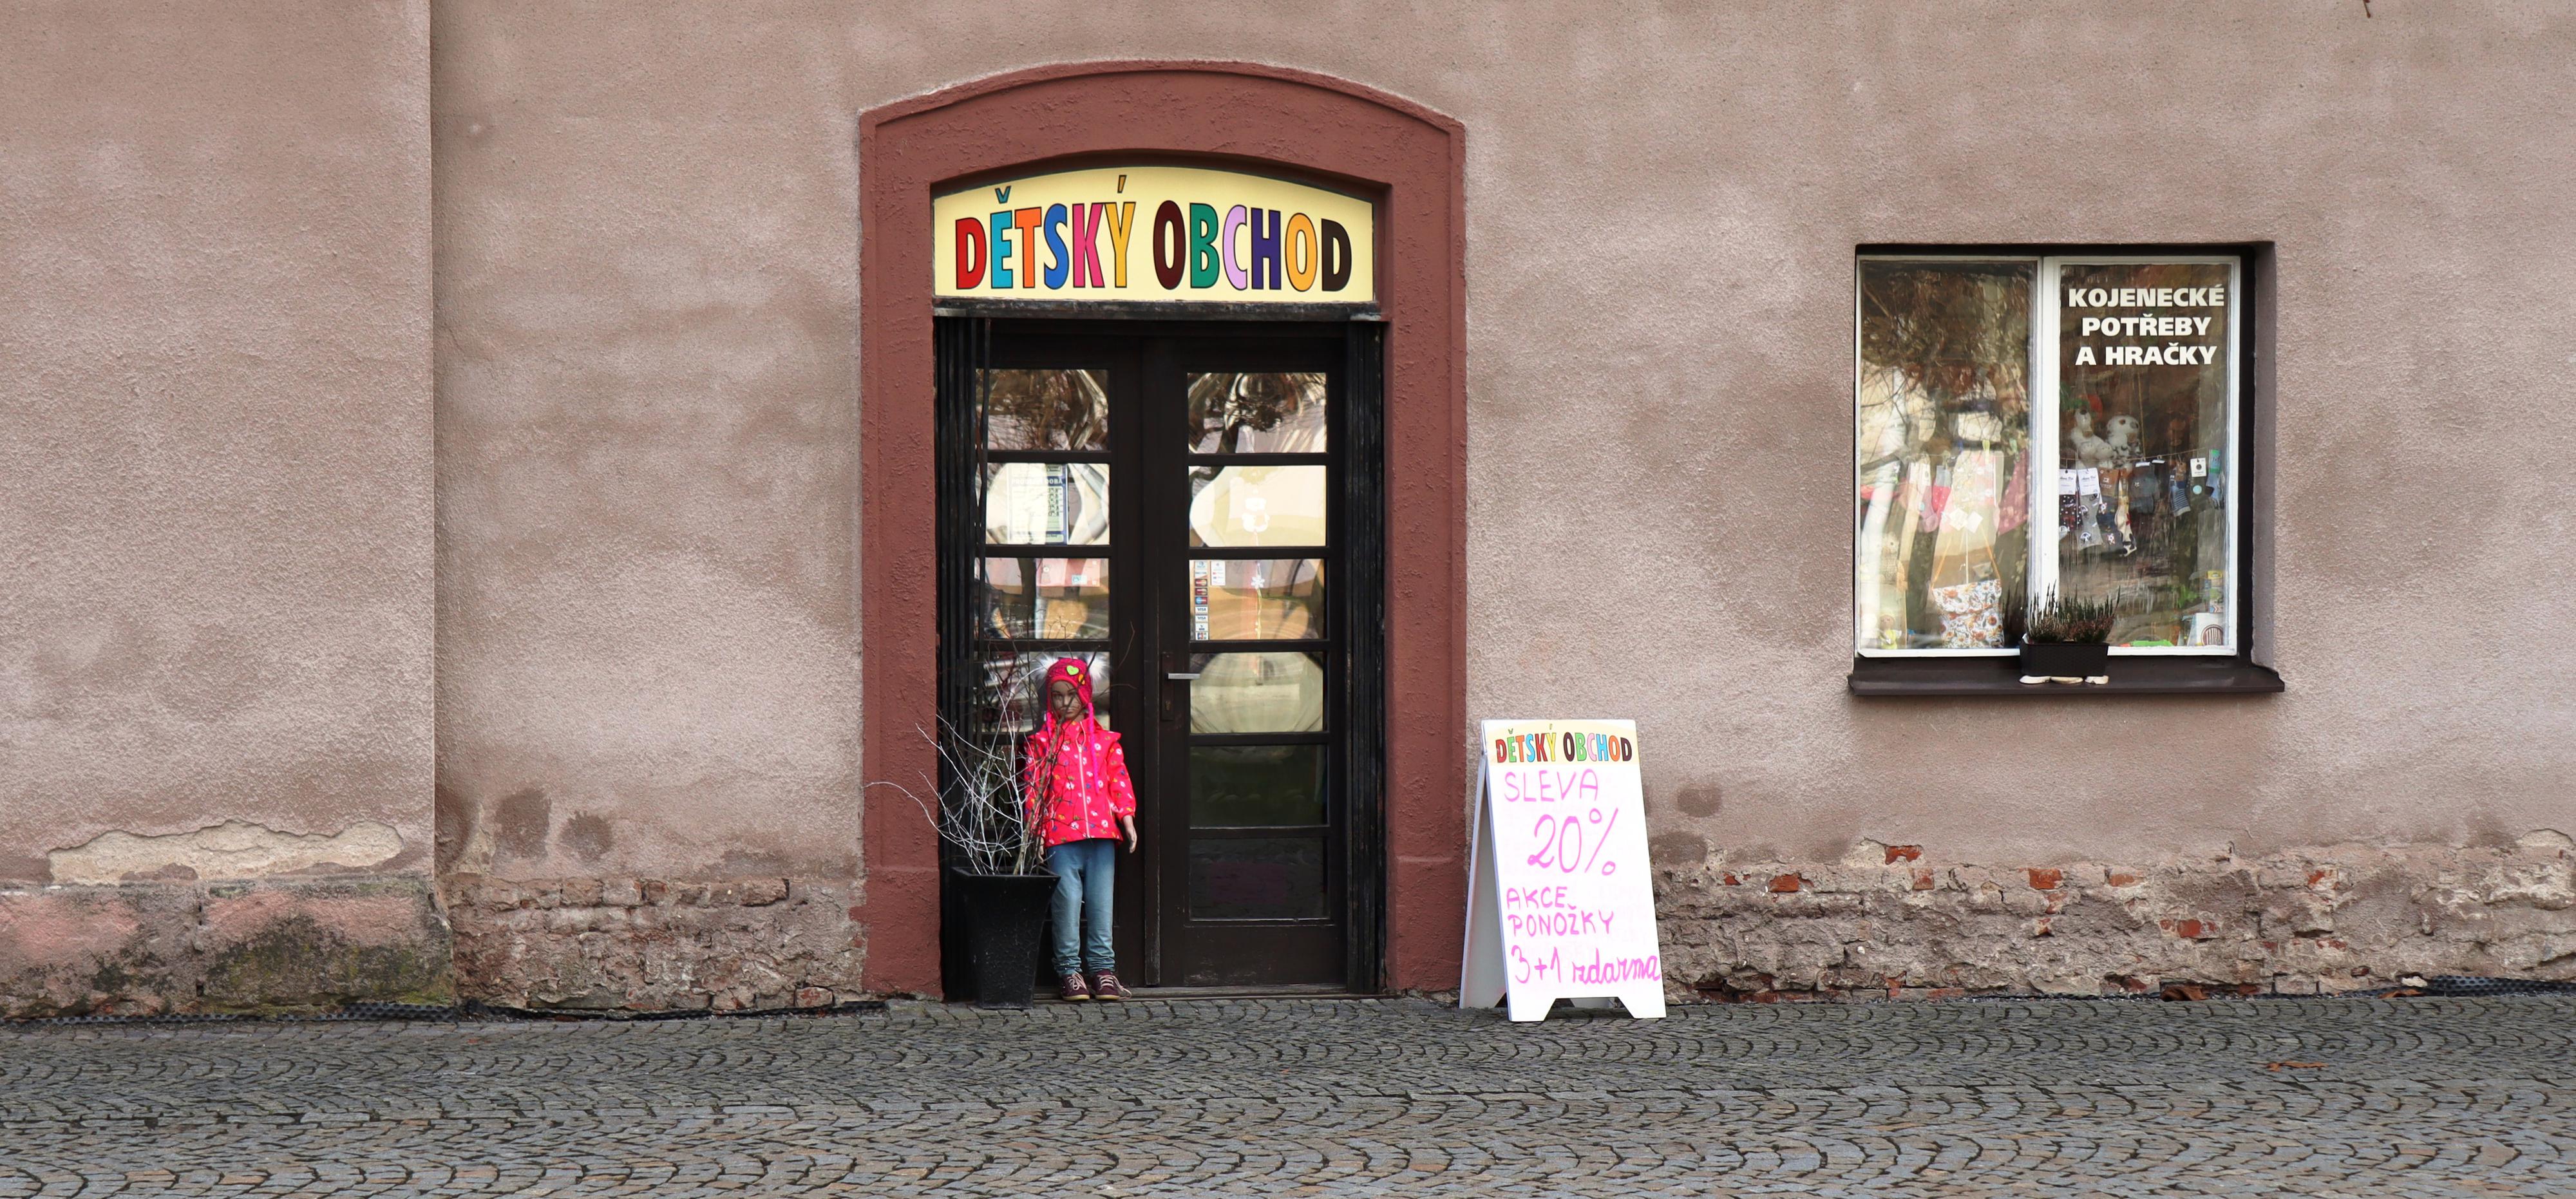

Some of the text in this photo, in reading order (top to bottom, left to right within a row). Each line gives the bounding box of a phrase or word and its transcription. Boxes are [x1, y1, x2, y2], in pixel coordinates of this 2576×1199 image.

[956, 175, 1352, 292] DĚTSKÝ OBCHOD
[2069, 284, 2224, 307] KOJENECKÉ
[2082, 313, 2212, 336] POTŘEBY
[2075, 342, 2217, 366] A HRAČKY
[1495, 724, 1632, 763] DĚTSKÝ OBCHOD
[1504, 768, 1599, 802] SLEVA
[1527, 807, 1618, 876] 20%
[1506, 886, 1567, 910] AKCE
[1508, 903, 1614, 938] PONOŽKY
[1511, 945, 1661, 985] 3+1 zdarma
